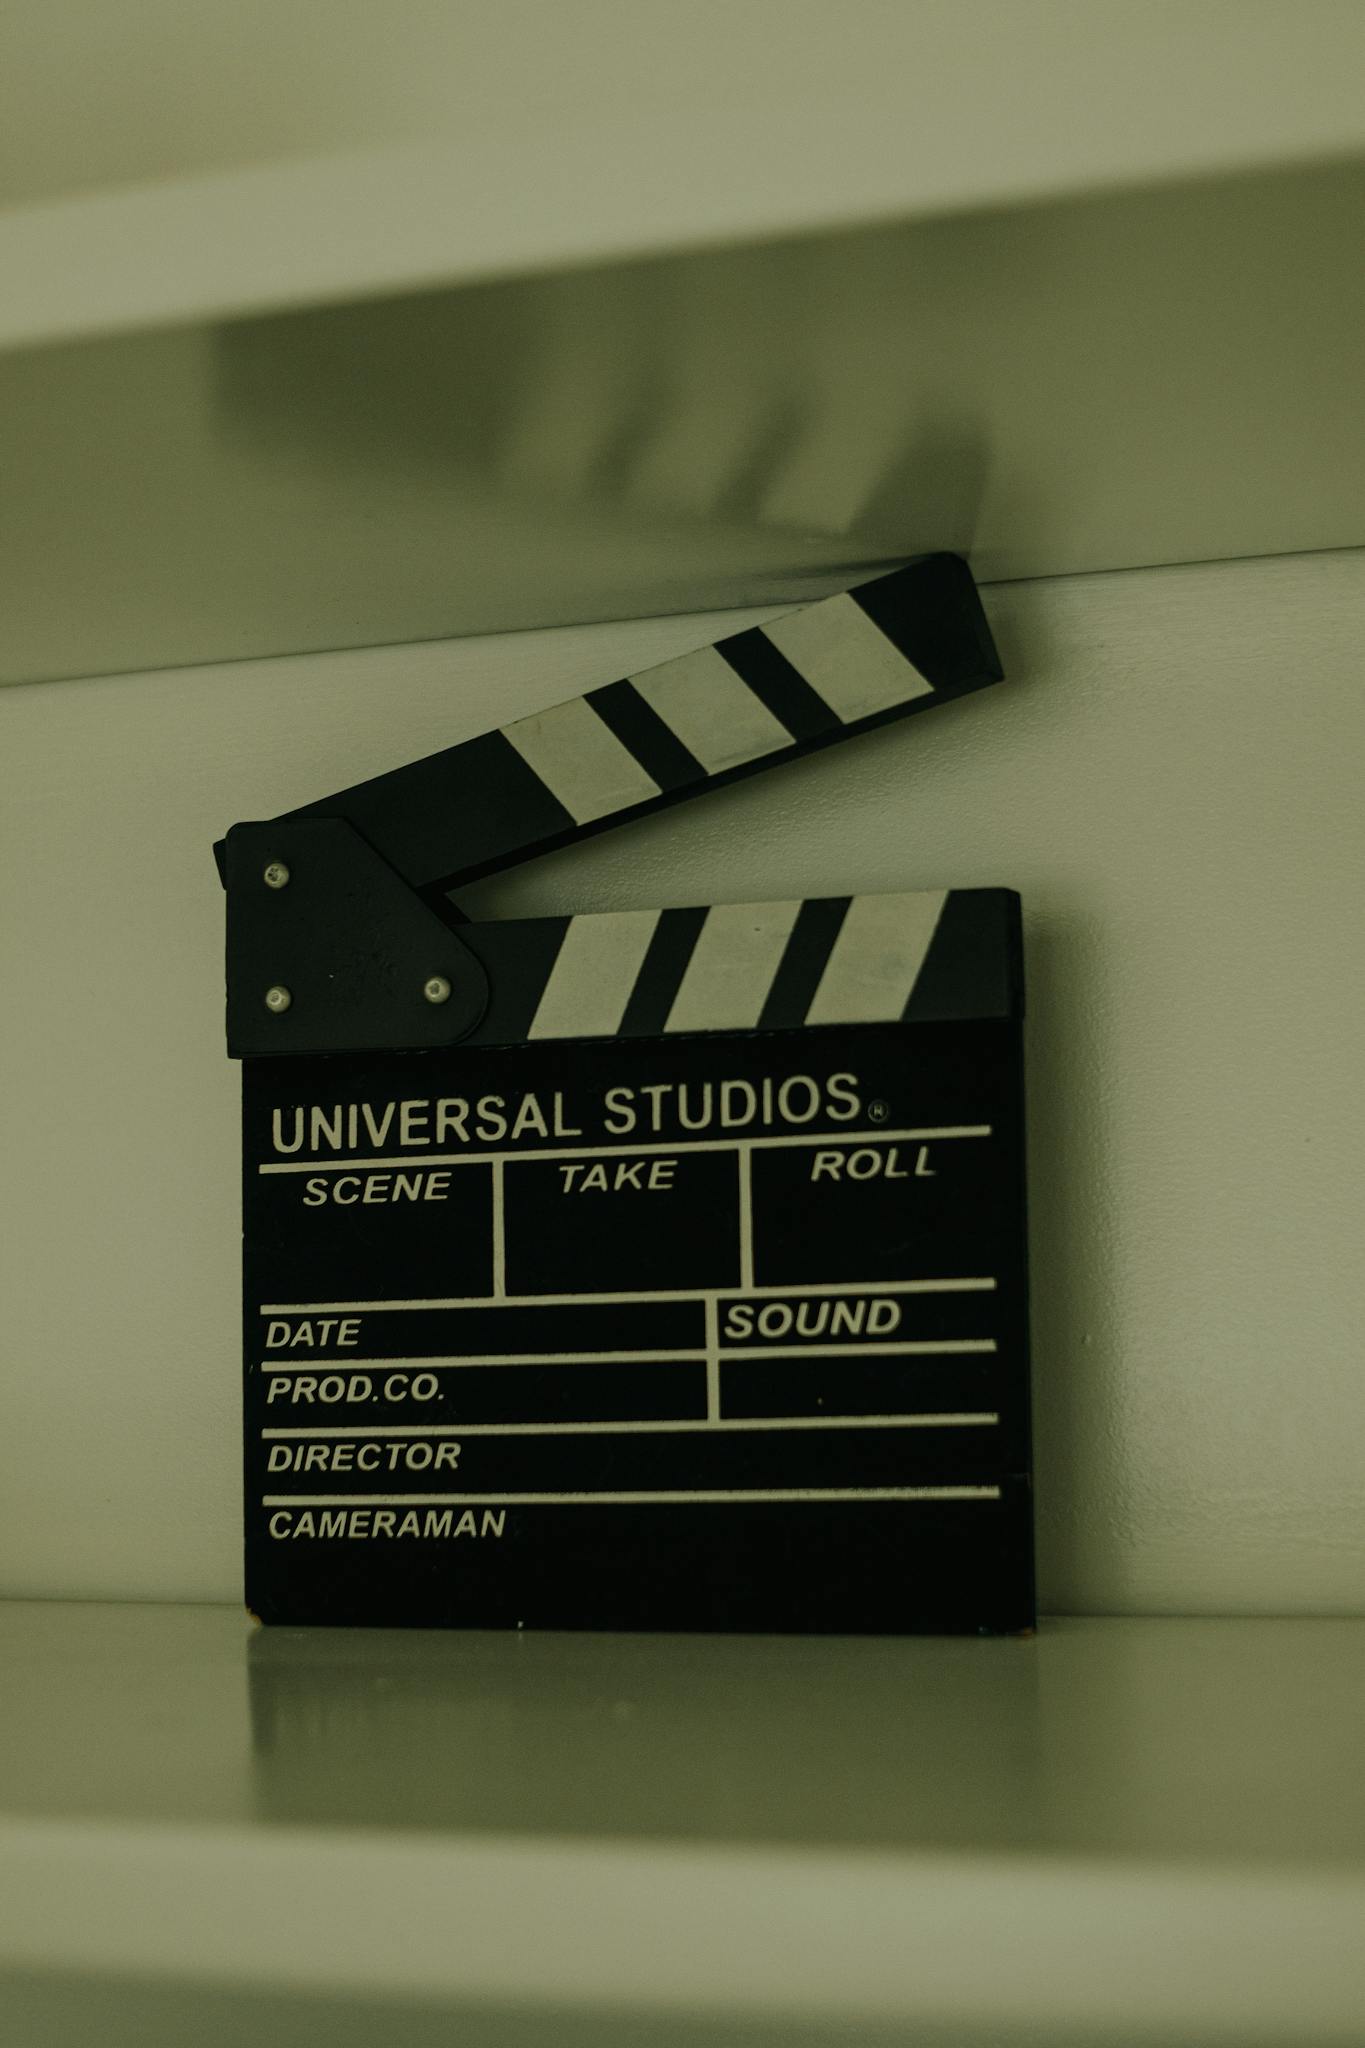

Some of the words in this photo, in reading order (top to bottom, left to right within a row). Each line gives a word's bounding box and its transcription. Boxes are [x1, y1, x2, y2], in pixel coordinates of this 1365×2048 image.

[272, 1092, 582, 1154] UNIVERSAL
[559, 1160, 678, 1193] TAKE
[811, 1146, 937, 1181] ROLL
[302, 1172, 452, 1206] SCENE
[265, 1318, 362, 1348] DATE
[724, 1299, 902, 1339] SOUND
[267, 1442, 462, 1472] DIRECTOR
[269, 1510, 507, 1539] CAMERAMAN
